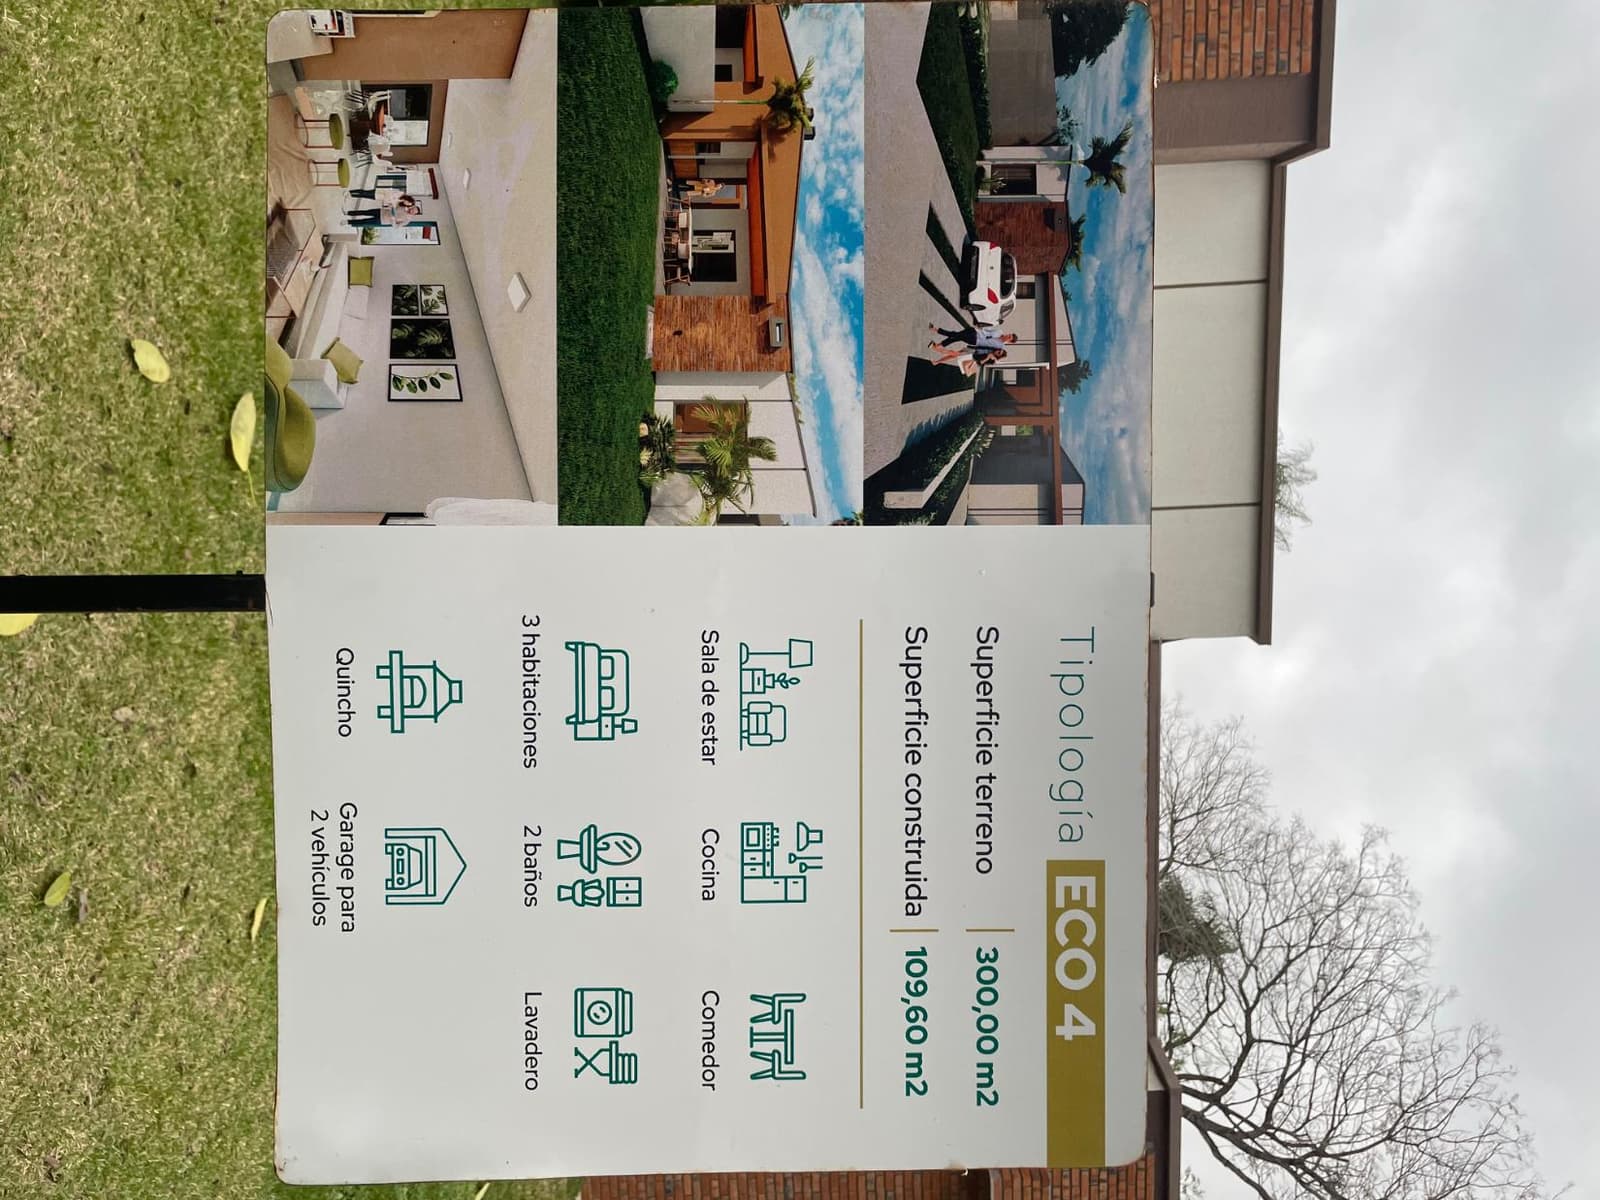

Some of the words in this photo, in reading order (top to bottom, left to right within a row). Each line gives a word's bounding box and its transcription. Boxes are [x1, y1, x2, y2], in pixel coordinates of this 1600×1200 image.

[521, 614, 541, 628] 3
[700, 629, 721, 674] Sala
[335, 647, 357, 738] Quincho
[520, 633, 542, 769] habitaciones
[700, 679, 721, 707] de
[898, 625, 930, 766] Superficie
[969, 625, 1001, 766] Superficie
[1048, 625, 1096, 845] Tipología
[700, 711, 720, 767] estar
[310, 809, 330, 823] 2
[334, 801, 359, 881] Garage
[523, 824, 543, 838] 2
[904, 772, 929, 917] construida
[975, 771, 998, 875] terreno
[310, 826, 332, 927] vehículos
[523, 842, 543, 908] baños
[700, 828, 721, 902] Cocina
[335, 885, 356, 933] para
[1055, 876, 1096, 990] ECO
[900, 945, 929, 1046] 109,60
[970, 945, 1000, 1056] 300,00
[1055, 1004, 1095, 1040] 4
[524, 991, 544, 1091] Lavadero
[701, 989, 721, 1092] Comedor
[904, 1051, 929, 1097] m2
[975, 1061, 1000, 1107] m2
